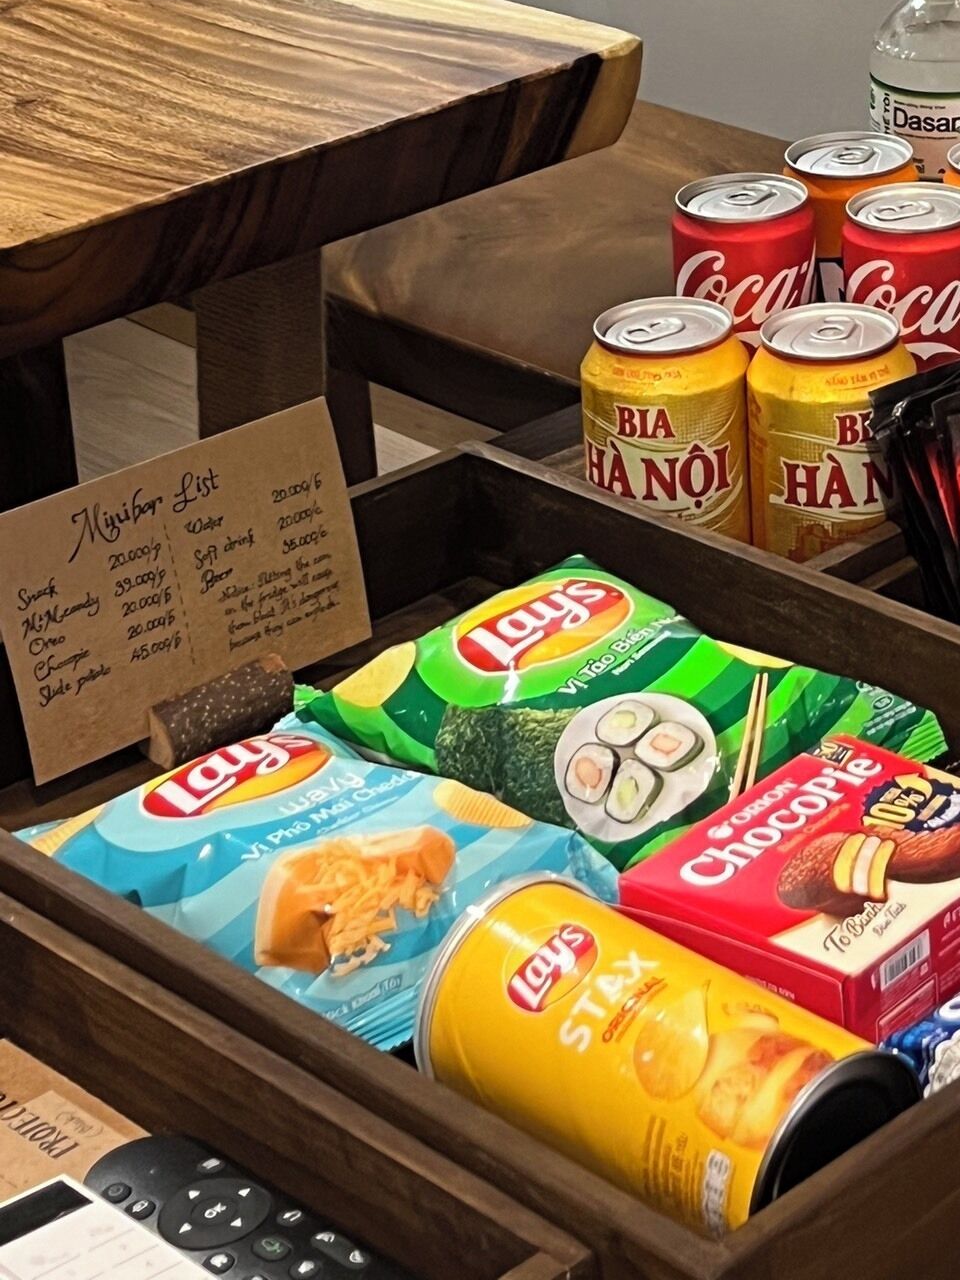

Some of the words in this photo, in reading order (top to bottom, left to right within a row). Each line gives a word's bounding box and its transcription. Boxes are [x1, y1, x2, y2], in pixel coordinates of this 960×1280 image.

[615, 405, 676, 439] BIA
[835, 412, 876, 446] BI
[587, 439, 637, 501] HÀ
[641, 442, 732, 510] NỘI
[781, 453, 858, 508] HÀ
[68, 487, 164, 563] Minibar
[172, 467, 220, 514] List
[184, 515, 225, 535] Water
[223, 528, 256, 555] drink
[16, 577, 59, 611] Snack
[481, 577, 608, 667] Lay's
[28, 633, 67, 657] Oreo
[556, 677, 590, 697] Vị
[582, 652, 616, 680] Tảo
[278, 771, 367, 815] wavy
[731, 777, 799, 827] ORION
[862, 786, 926, 831] 10%
[240, 841, 270, 864] Vị
[312, 798, 354, 825] Mai
[823, 931, 851, 956] To
[509, 925, 586, 1010] Lay's
[559, 950, 660, 1053] STAX
[203, 1202, 228, 1220] OK
